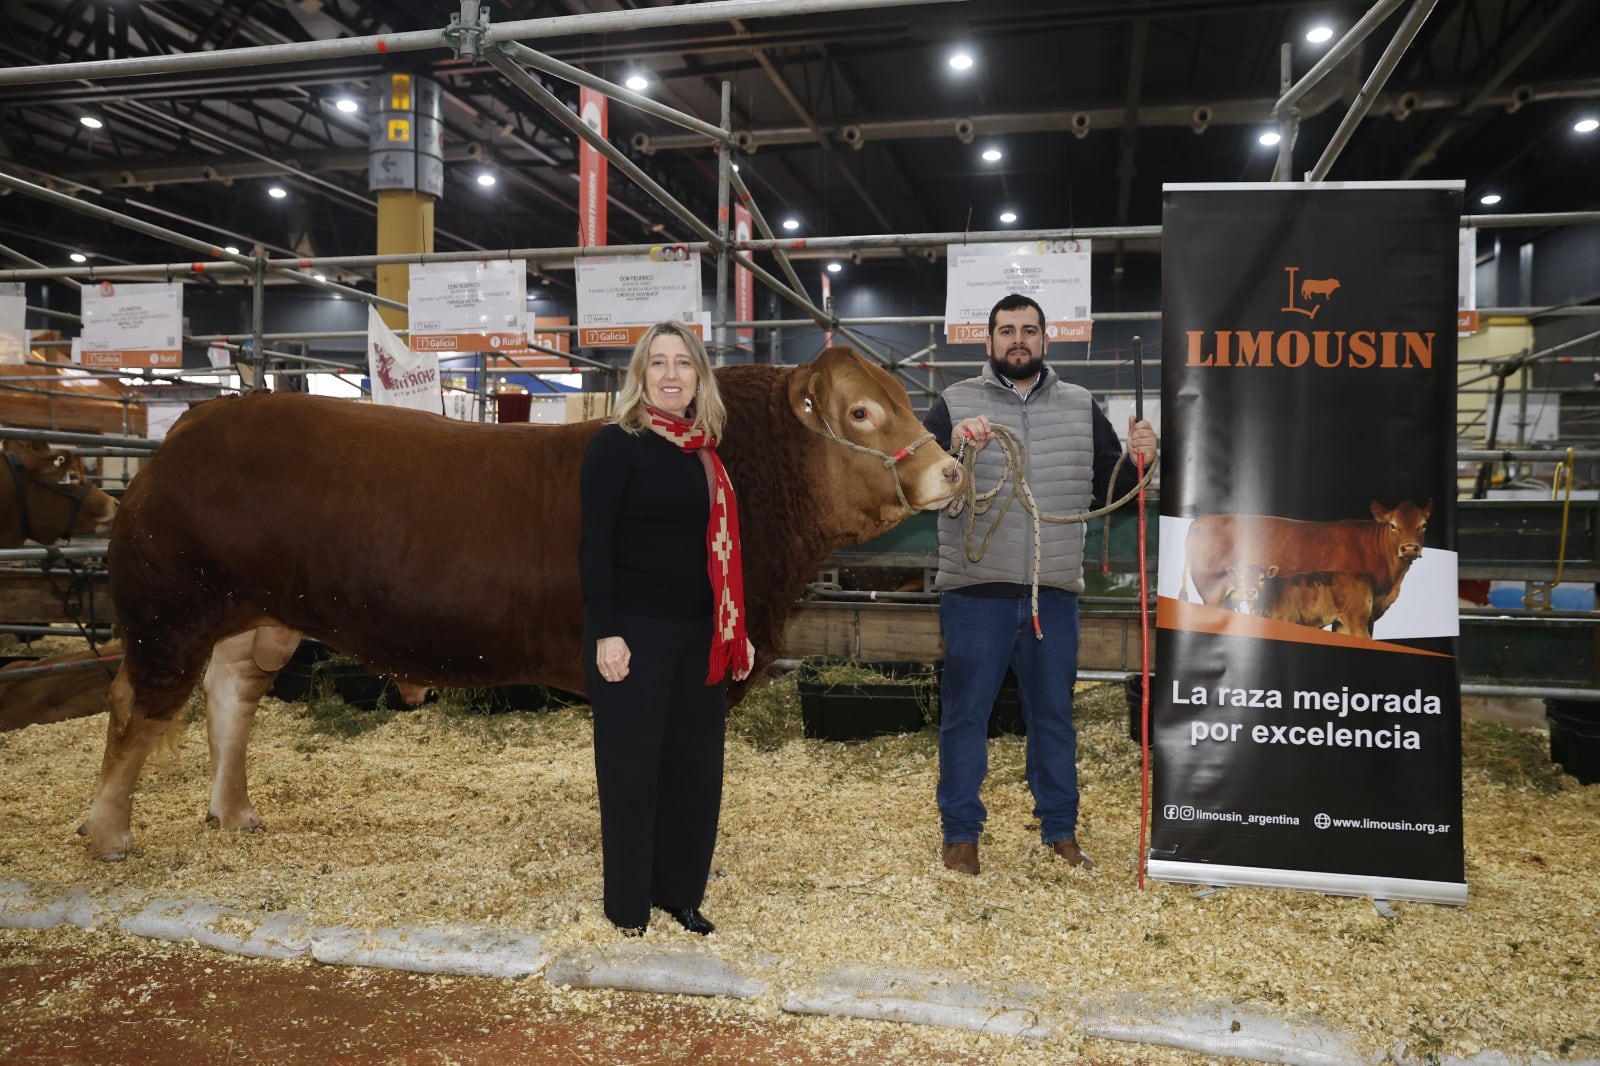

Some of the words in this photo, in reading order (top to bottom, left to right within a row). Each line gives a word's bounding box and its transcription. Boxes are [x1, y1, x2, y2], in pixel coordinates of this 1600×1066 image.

[599, 332, 626, 341] Galicia
[1061, 326, 1084, 336] Rural
[430, 338, 455, 348] Galicia
[502, 337, 522, 346] Rural
[1185, 330, 1435, 369] LIMOUSIN
[1172, 680, 1207, 705] La
[1218, 686, 1282, 709] raza
[1293, 687, 1441, 717] mejorada
[1190, 720, 1243, 745] por
[1252, 721, 1420, 750] excelencia
[1196, 810, 1300, 826] limousin_argentina
[1333, 819, 1450, 835] www.limousin.org.ar
